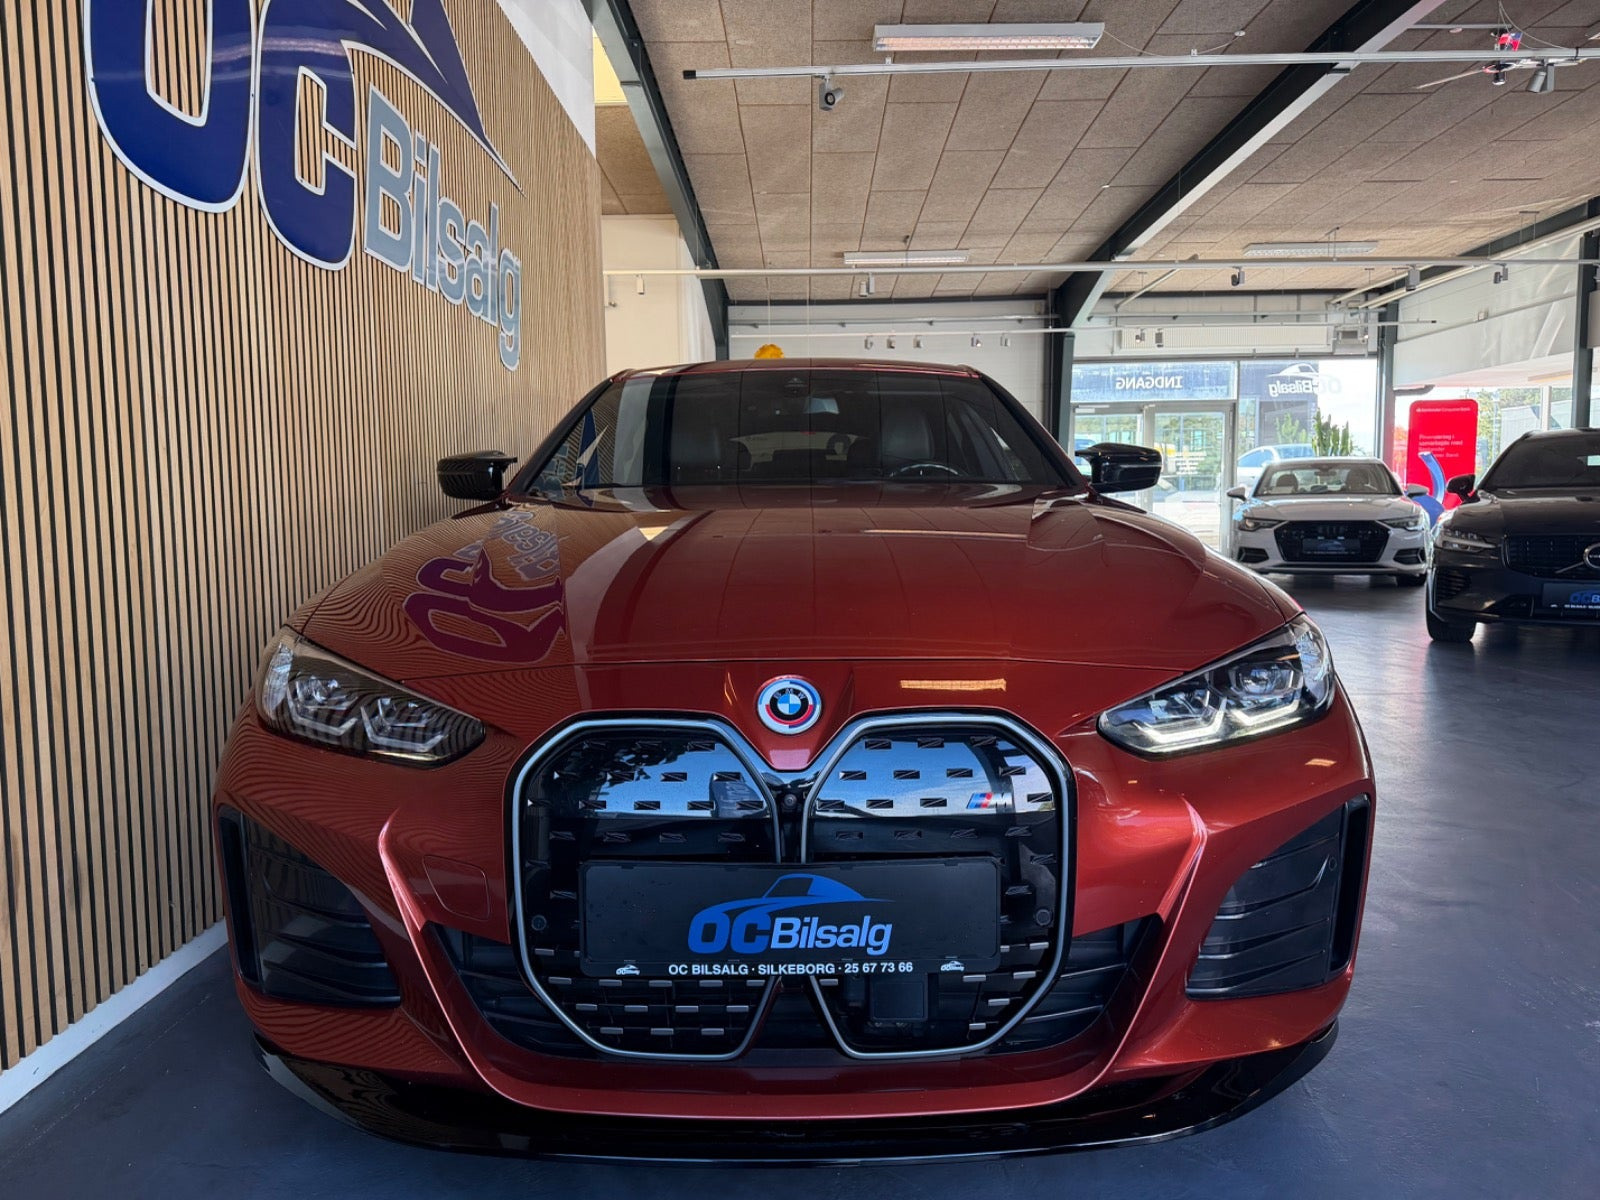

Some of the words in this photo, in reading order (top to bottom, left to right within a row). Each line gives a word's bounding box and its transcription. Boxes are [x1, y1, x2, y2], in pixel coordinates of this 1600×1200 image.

[773, 687, 806, 700] BMW
[668, 963, 689, 976] OC
[691, 963, 749, 976] BILSALG
[758, 962, 836, 976] SILKEBORG
[844, 962, 860, 974] 25
[862, 962, 876, 973] 67
[880, 962, 896, 973] 73
[898, 961, 914, 973] 66
